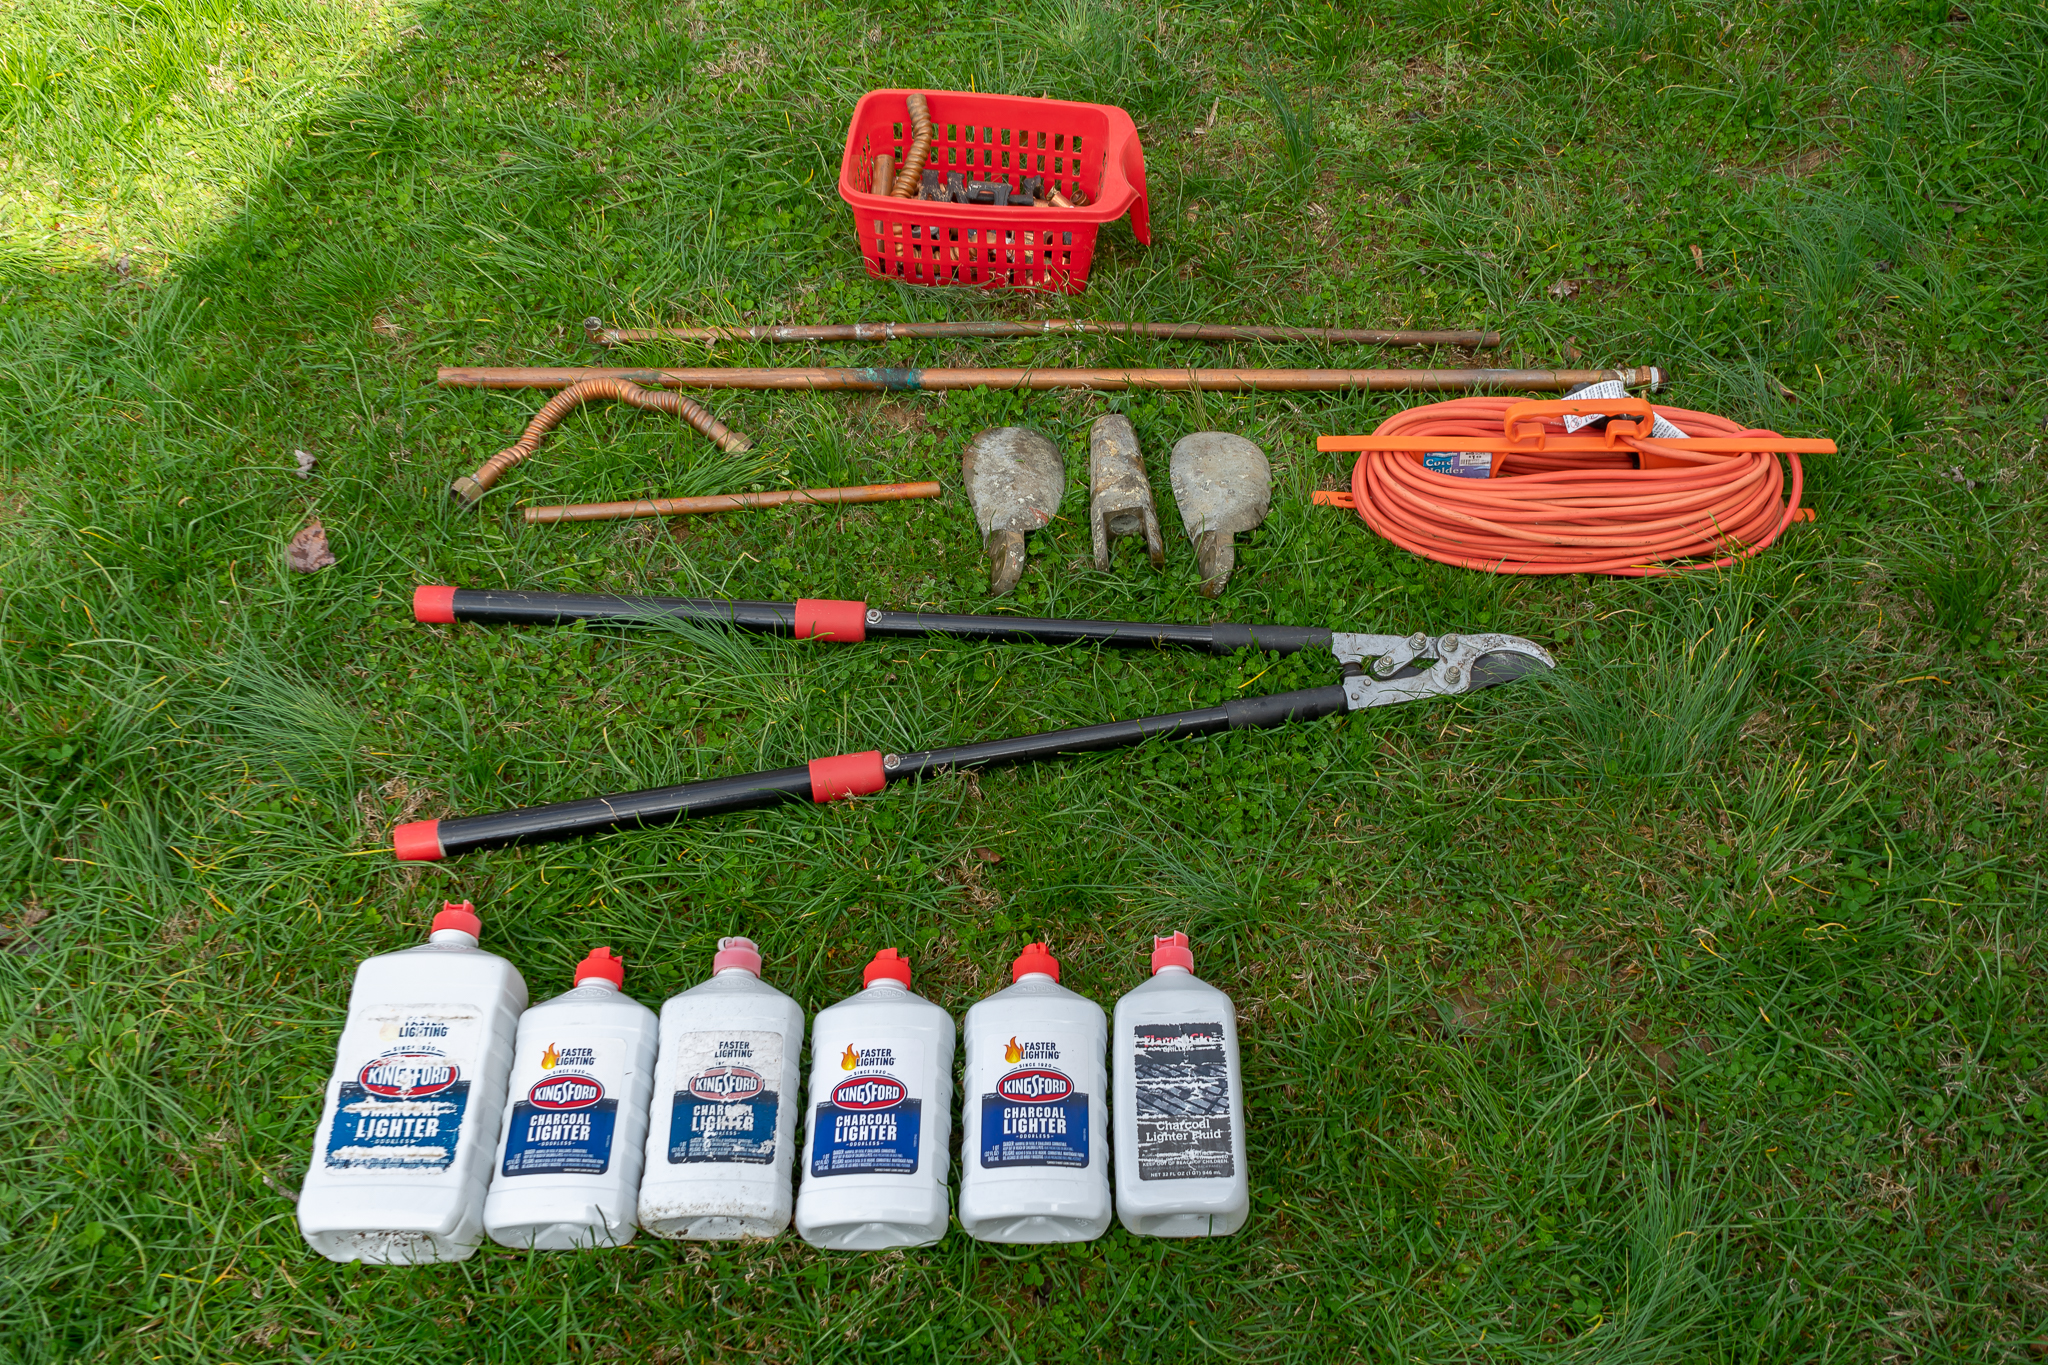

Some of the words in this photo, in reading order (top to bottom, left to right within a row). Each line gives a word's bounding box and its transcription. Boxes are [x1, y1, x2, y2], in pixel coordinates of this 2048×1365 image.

[1425, 458, 1453, 466] Cord
[719, 1041, 750, 1049] FASTER
[1024, 1042, 1056, 1051] FASTER
[560, 1048, 593, 1057] FASTER
[714, 1049, 753, 1058] LIGHTING
[860, 1049, 892, 1057] FASTER
[1020, 1051, 1060, 1060] LIGHTING
[555, 1057, 595, 1066] LIGHTING
[856, 1057, 895, 1067] LIGHTING
[367, 1064, 450, 1090] KINGFORD
[695, 1072, 758, 1096] KINGSFORD
[534, 1080, 598, 1105] KINGSFORD
[837, 1081, 900, 1105] KINGSFORD
[1003, 1074, 1067, 1098] KINGSFORD
[1003, 1106, 1066, 1119] CHARCOAL
[529, 1113, 591, 1127] CHARCOAL
[690, 1115, 754, 1132] LIGHTER
[836, 1113, 897, 1127] CHARCOAL
[1003, 1118, 1067, 1134] LIGHTER
[1156, 1119, 1211, 1131] Charcoal
[354, 1118, 440, 1138] LIGHTER
[526, 1124, 591, 1142] LIGHTER
[834, 1125, 897, 1143] LIGHTER
[1145, 1131, 1188, 1144] Lighter
[1191, 1129, 1222, 1140] Fluid
